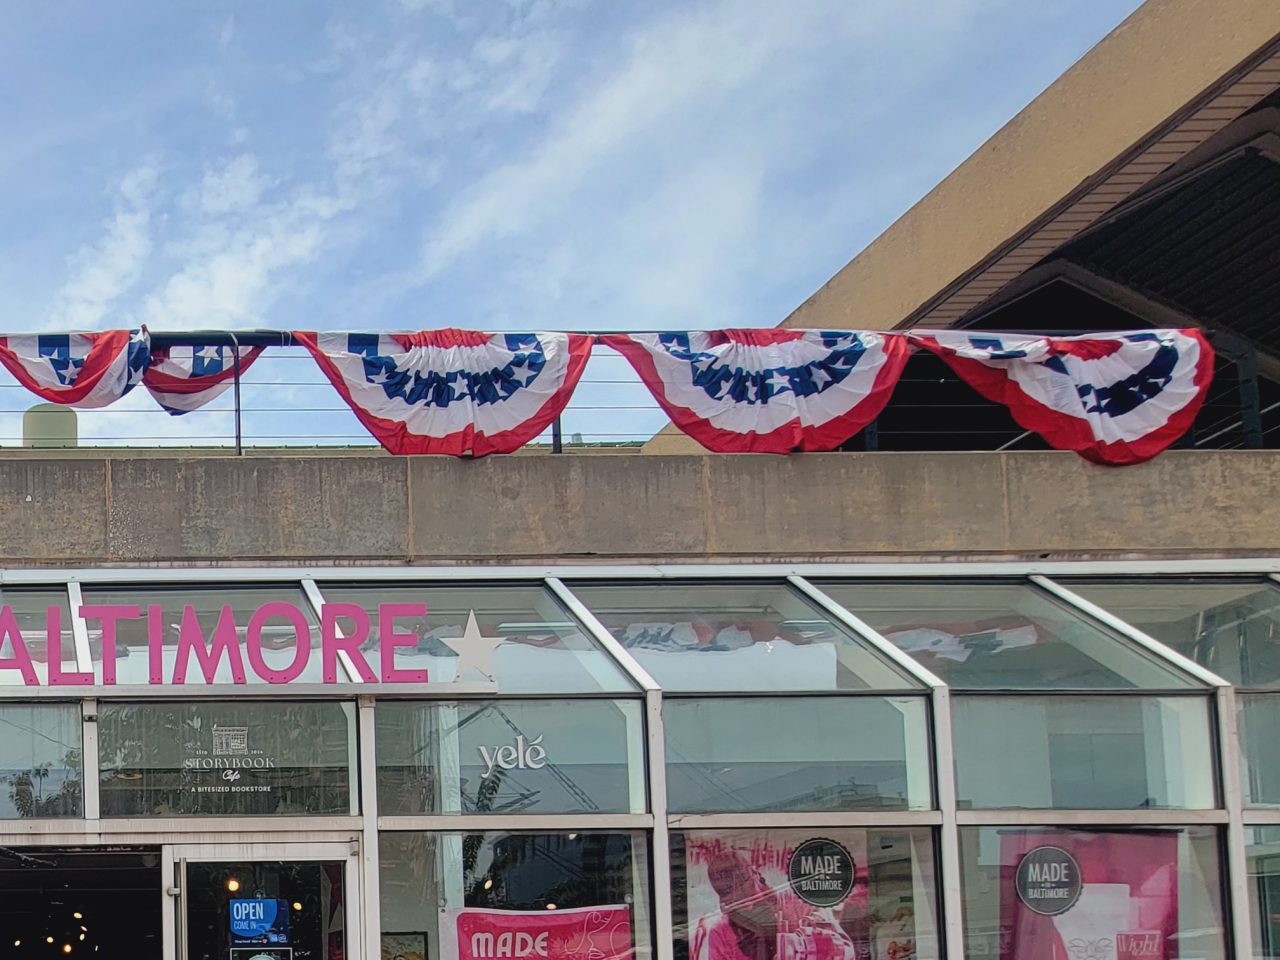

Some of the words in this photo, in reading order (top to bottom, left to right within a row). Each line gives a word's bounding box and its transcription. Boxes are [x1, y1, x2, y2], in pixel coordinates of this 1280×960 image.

[184, 757, 275, 769] STORYBOOK
[478, 734, 546, 778] yelé
[801, 855, 842, 874] MADE
[1028, 863, 1069, 882] MADE
[801, 880, 842, 891] BALTIMORE
[1028, 888, 1069, 899] BALTIMORE
[233, 902, 264, 920] OPEN
[233, 921, 249, 930] COME
[250, 921, 257, 930] IN
[471, 931, 549, 957] MADE
